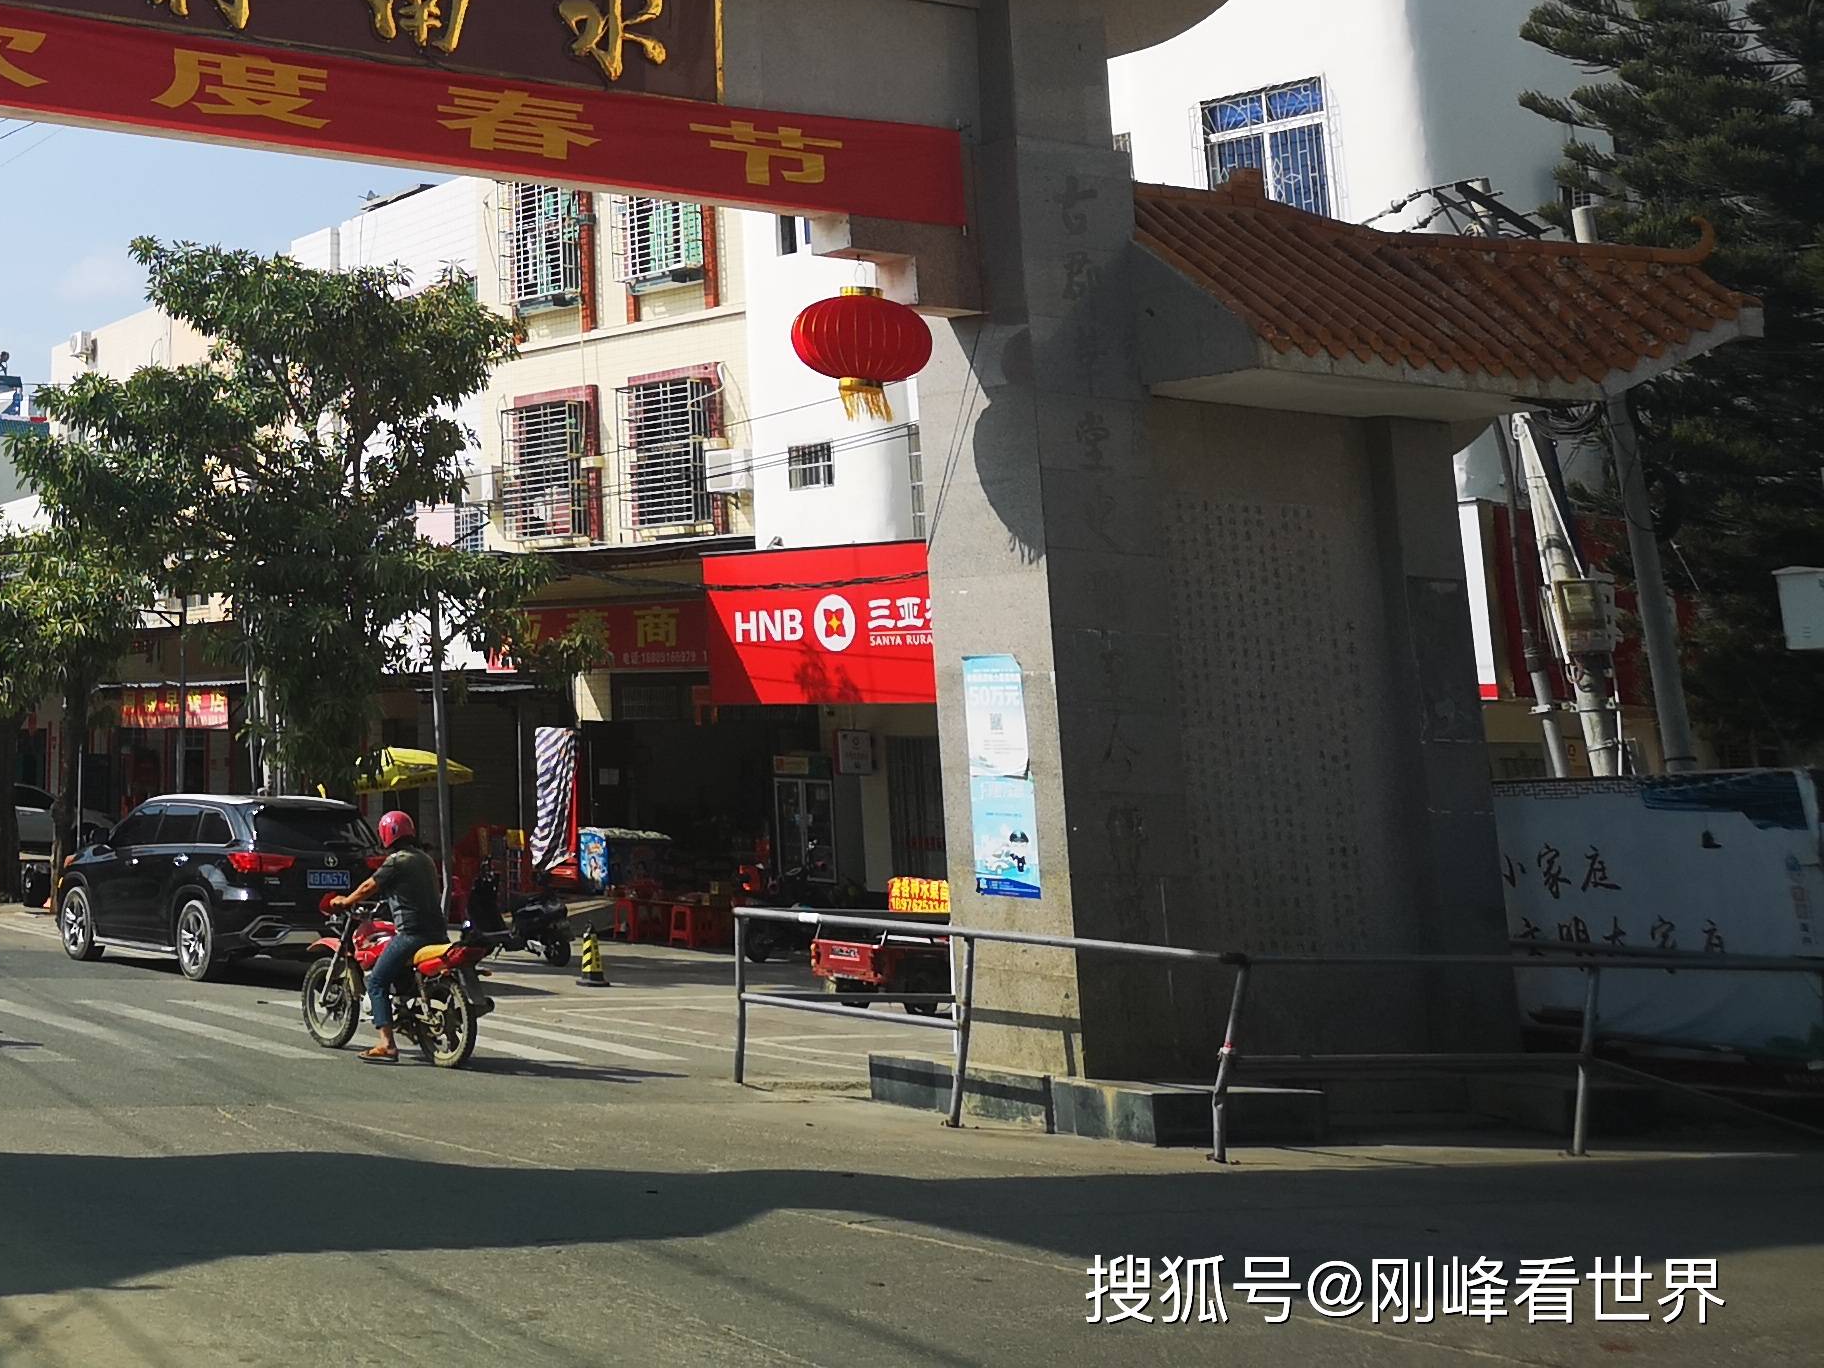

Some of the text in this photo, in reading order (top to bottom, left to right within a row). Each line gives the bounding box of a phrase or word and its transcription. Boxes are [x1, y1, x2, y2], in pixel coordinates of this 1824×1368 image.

[735, 608, 804, 643] HNB
[867, 596, 933, 629] 三亚
[870, 635, 902, 647] SANYA
